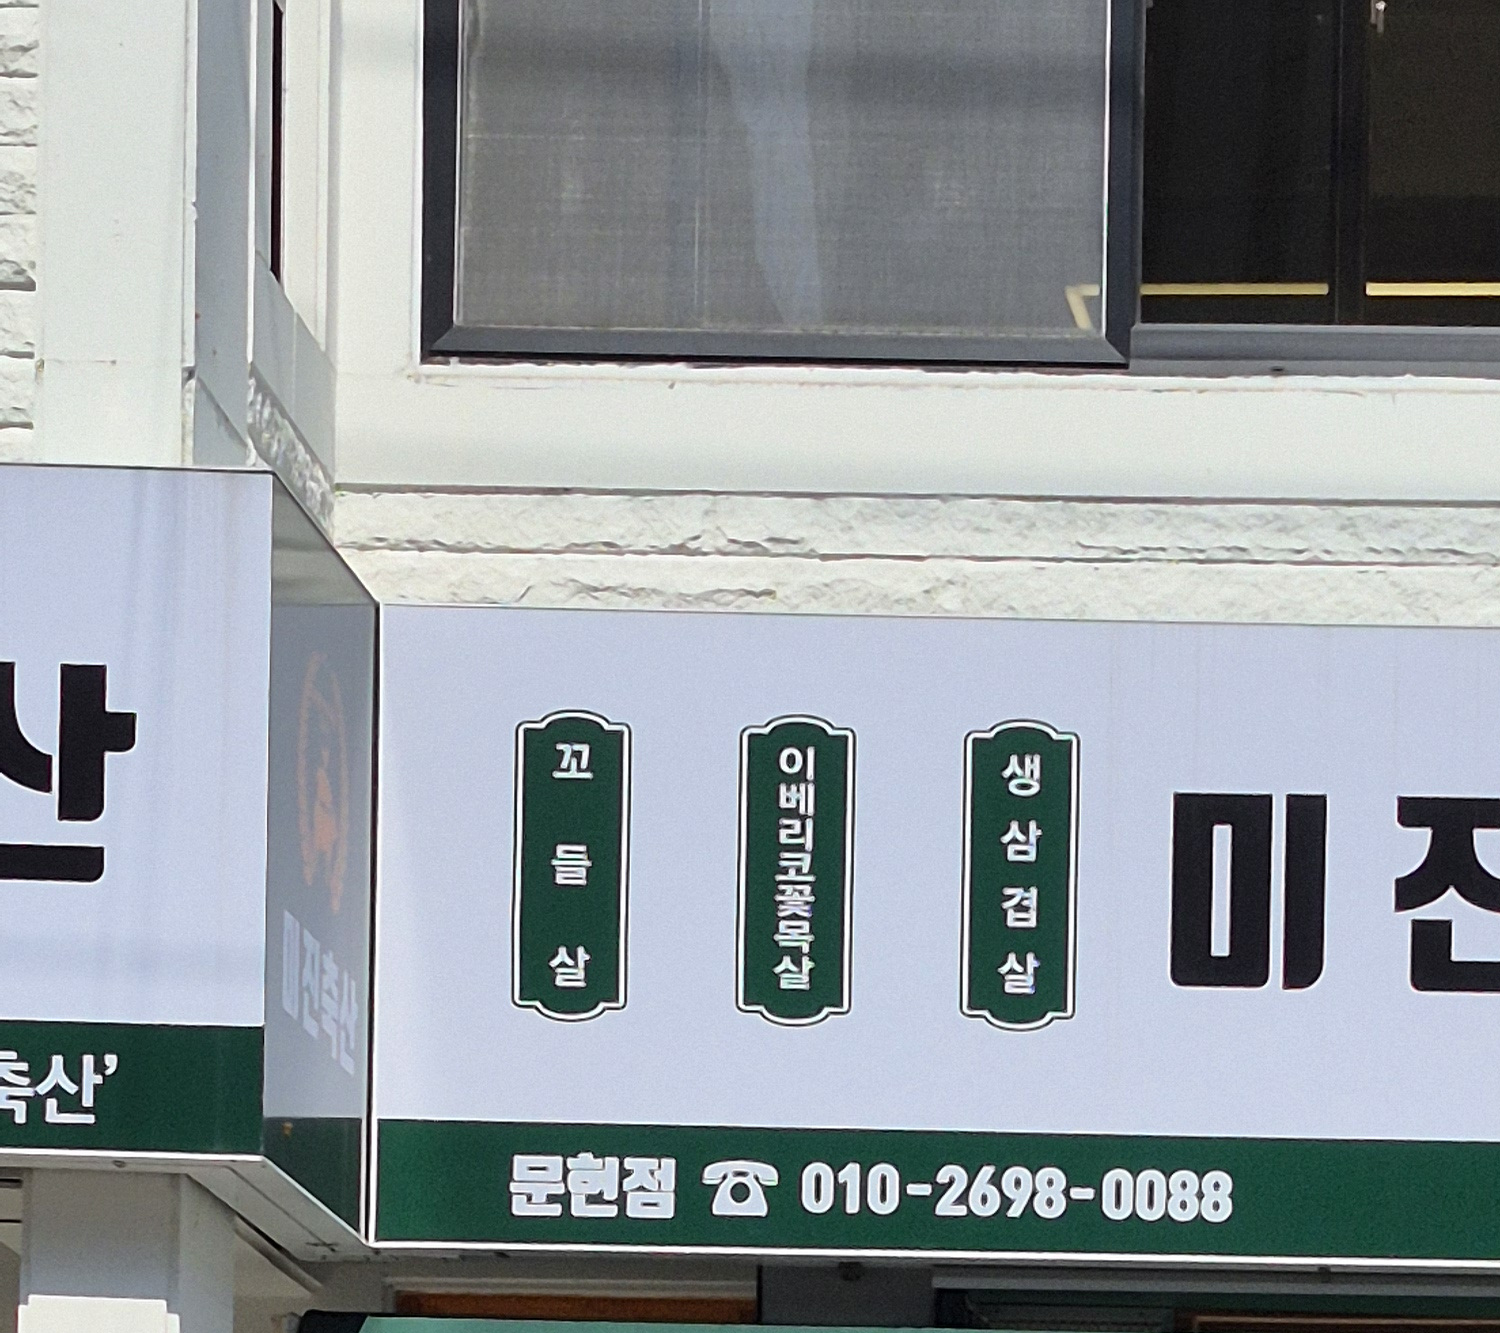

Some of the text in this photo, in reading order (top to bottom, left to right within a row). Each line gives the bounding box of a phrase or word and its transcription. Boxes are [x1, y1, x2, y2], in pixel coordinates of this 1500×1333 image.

[548, 741, 594, 988] 꼬들살
[772, 745, 816, 991] 이베리코꽃목살
[997, 753, 1043, 995] 생삼겹살
[508, 1151, 1235, 1225] 문현점 010-2698-0088
